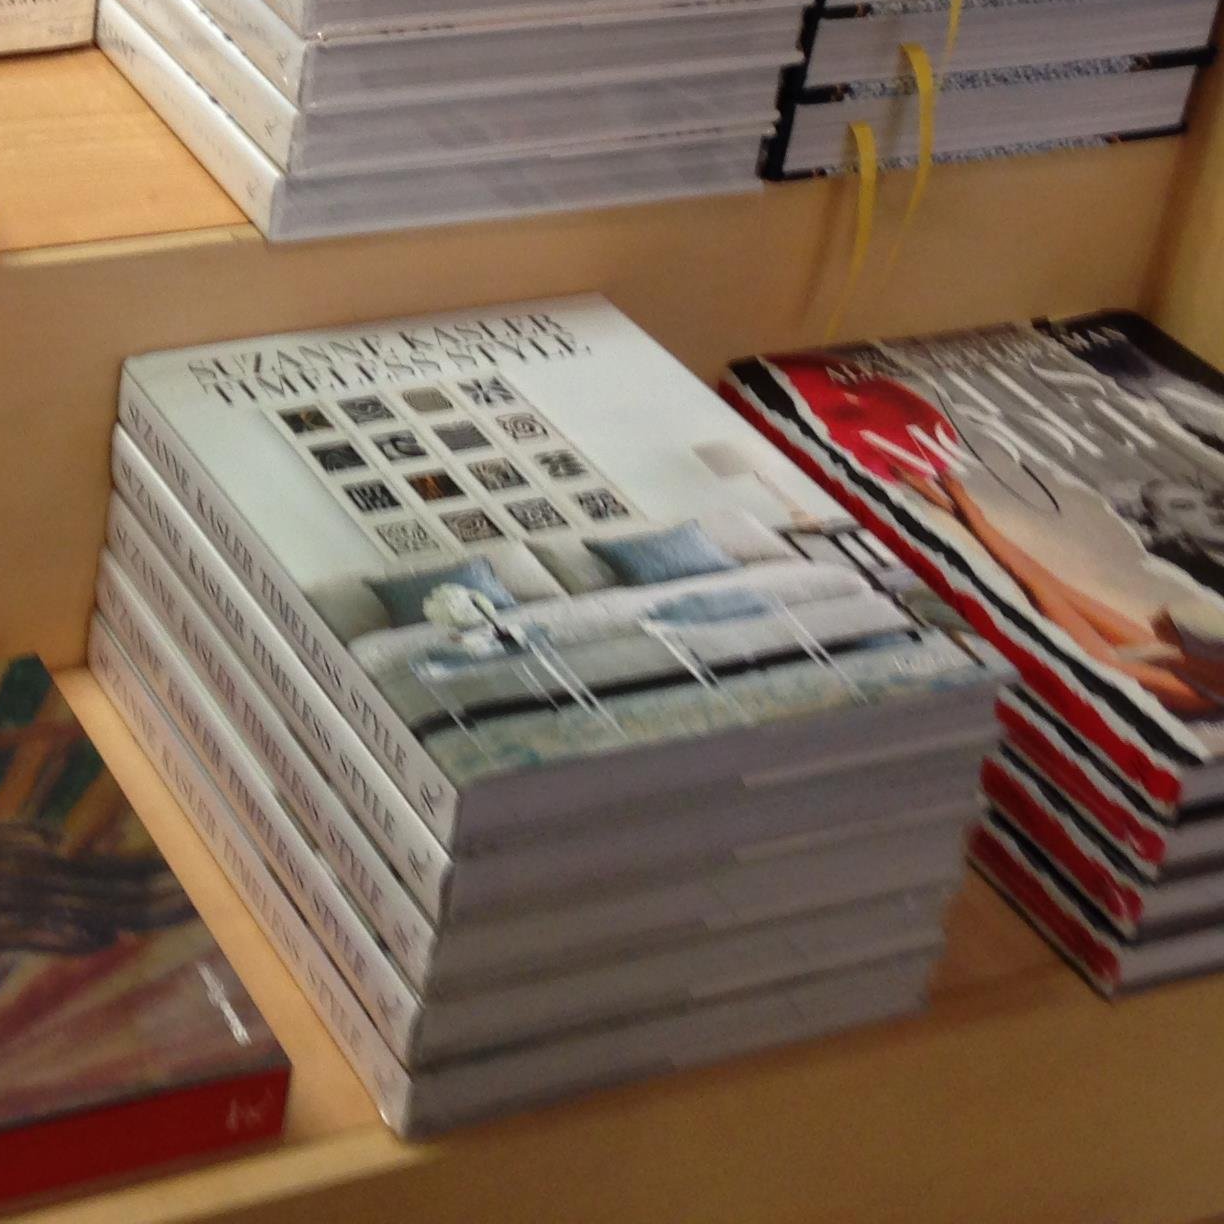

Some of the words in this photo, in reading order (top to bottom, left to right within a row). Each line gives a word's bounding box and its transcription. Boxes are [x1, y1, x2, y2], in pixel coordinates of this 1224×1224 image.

[187, 336, 388, 382] SUZANNE
[400, 312, 568, 353] KASLER
[196, 348, 443, 406] TIMELESS
[447, 330, 593, 374] STYLE
